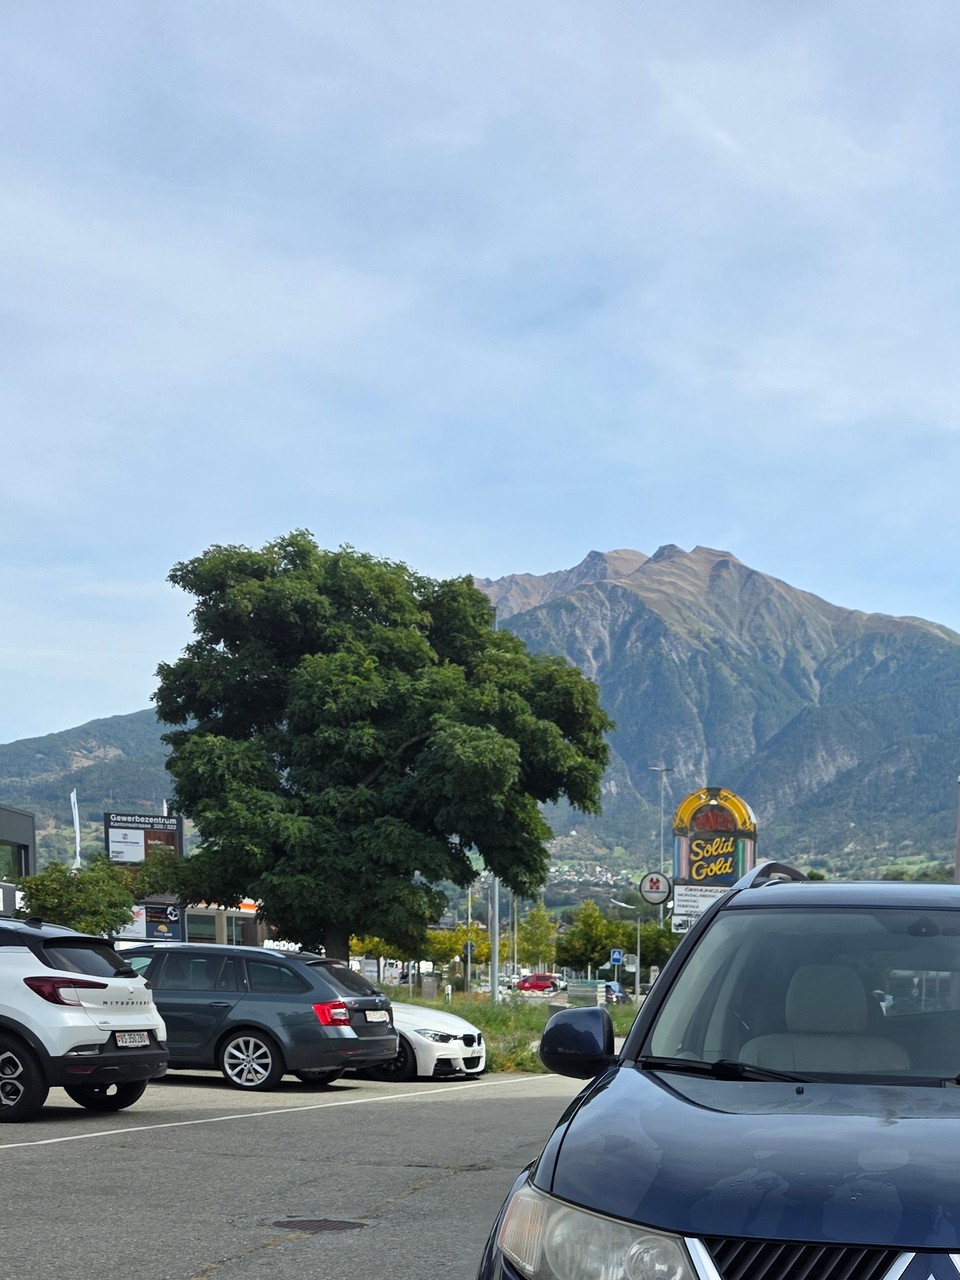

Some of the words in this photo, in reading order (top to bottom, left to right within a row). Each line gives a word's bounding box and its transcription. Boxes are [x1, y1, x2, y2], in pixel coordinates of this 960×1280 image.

[110, 814, 177, 824] Gewerbezentrum
[690, 837, 735, 861] Solid
[691, 857, 733, 880] Gold
